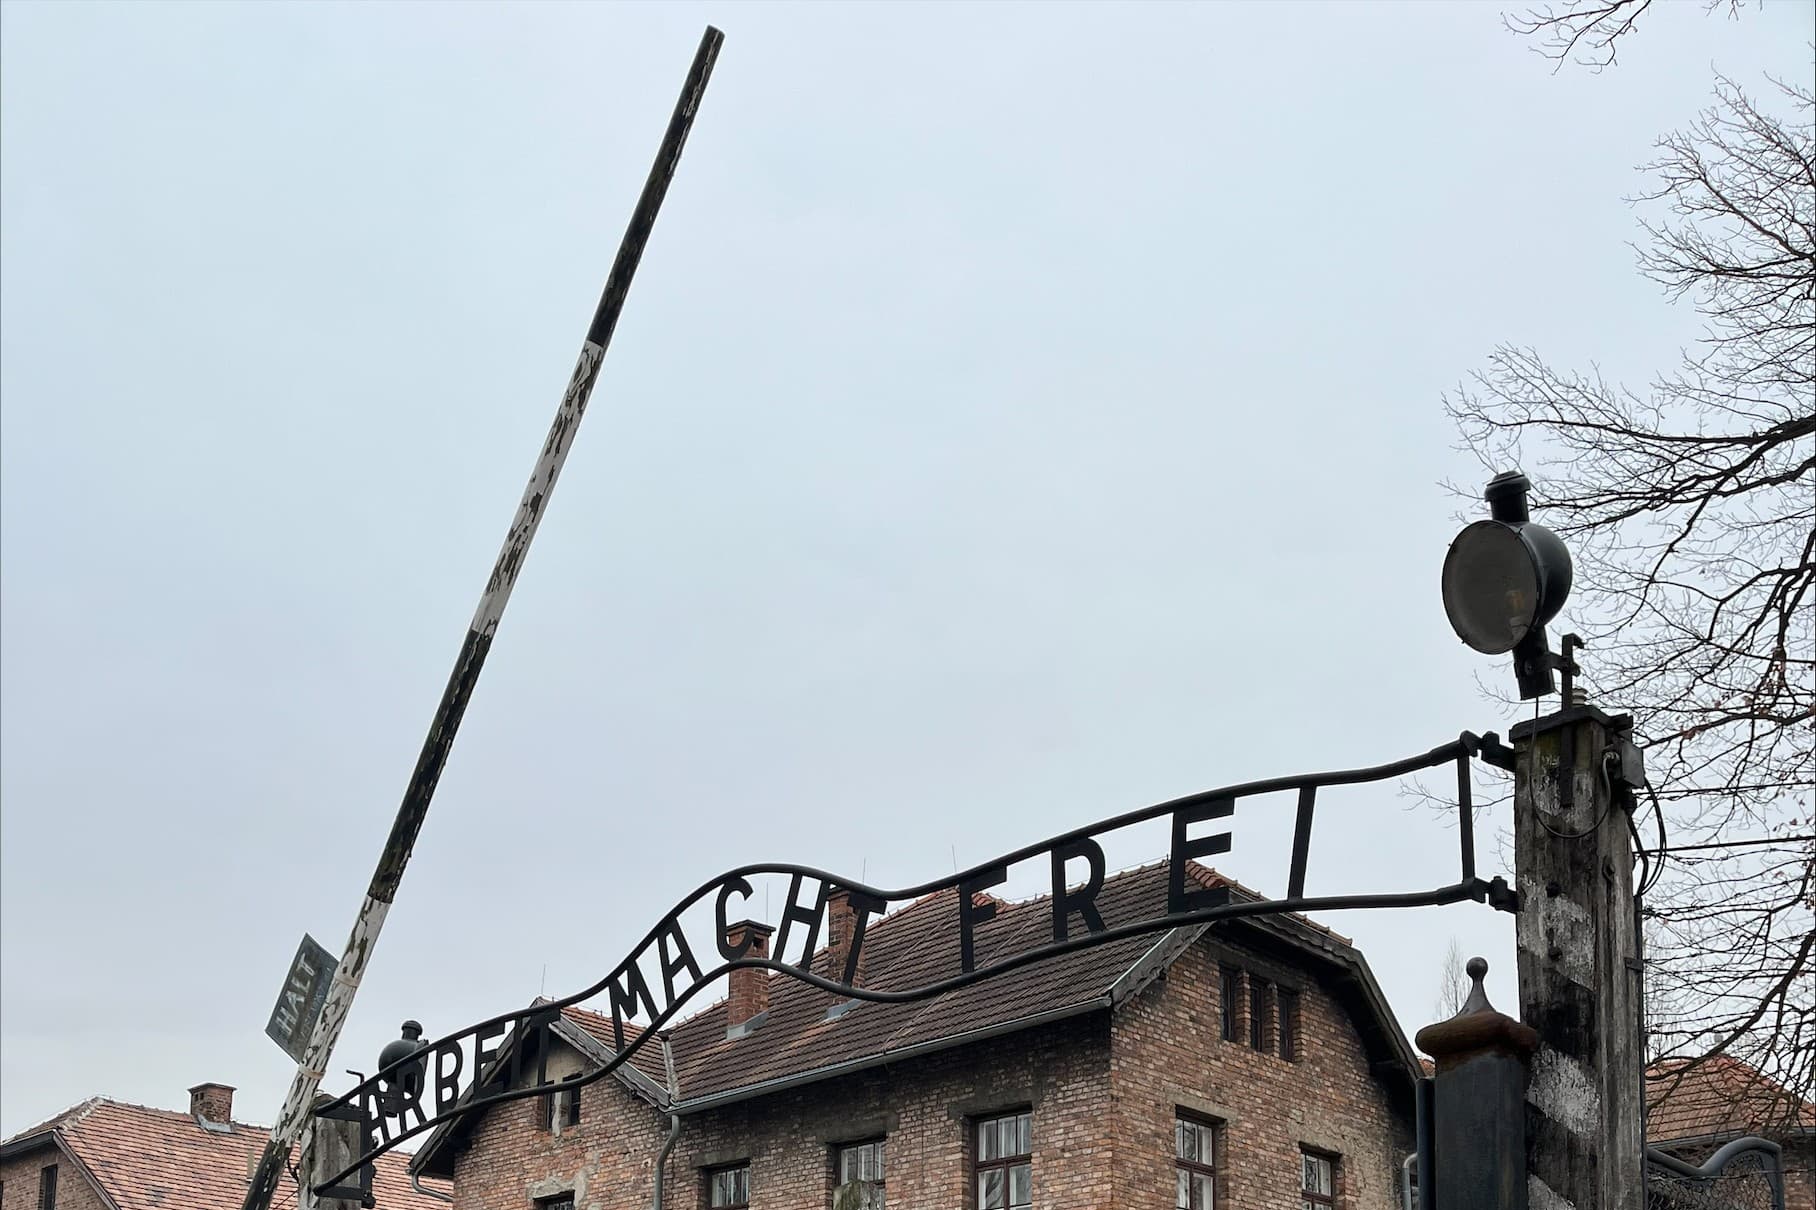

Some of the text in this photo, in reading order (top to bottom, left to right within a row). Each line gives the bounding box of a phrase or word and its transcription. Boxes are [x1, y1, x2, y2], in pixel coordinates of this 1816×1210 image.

[276, 952, 316, 1036] HALT
[361, 785, 1317, 1152] ARBEIT MACHT FREI
